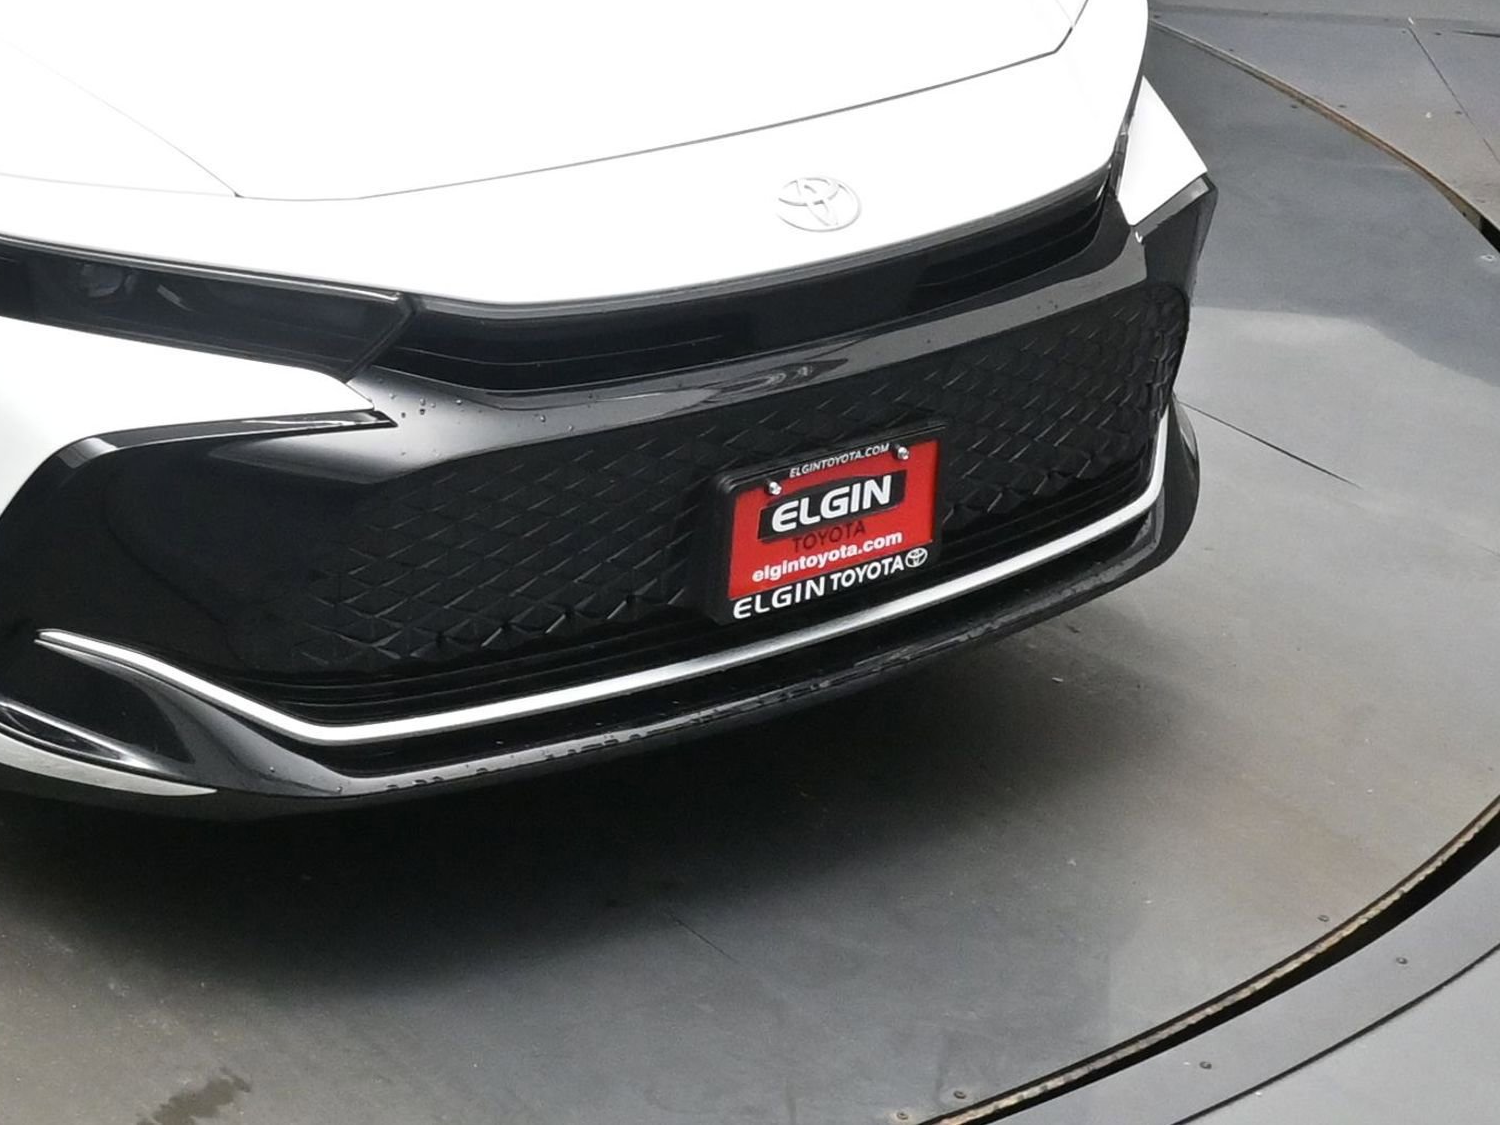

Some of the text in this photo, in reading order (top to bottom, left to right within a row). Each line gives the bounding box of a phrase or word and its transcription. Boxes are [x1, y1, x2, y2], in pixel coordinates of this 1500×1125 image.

[789, 443, 890, 478] ELGINTOYOTA.COM
[771, 474, 892, 533] ELGIN
[751, 532, 903, 582] elgintoyota.com
[792, 520, 867, 553] TOYOTA
[733, 555, 905, 619] ELGIN TOYOTA
